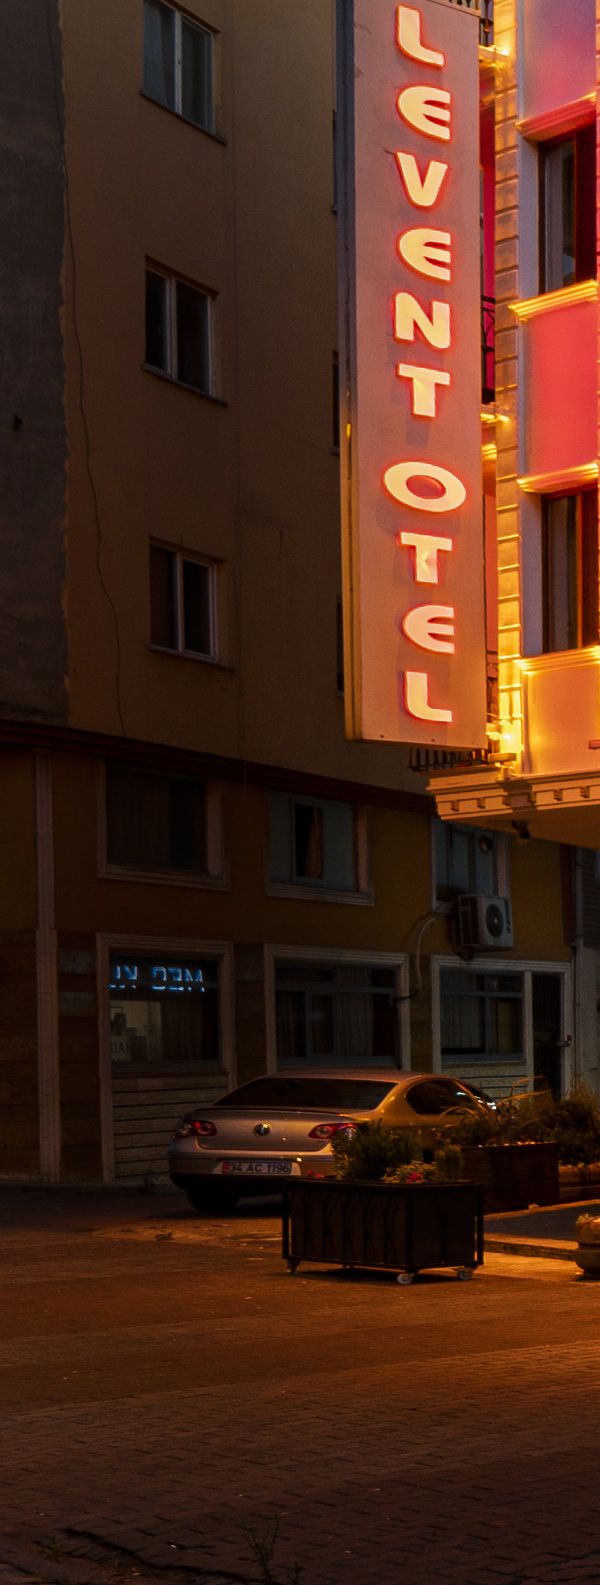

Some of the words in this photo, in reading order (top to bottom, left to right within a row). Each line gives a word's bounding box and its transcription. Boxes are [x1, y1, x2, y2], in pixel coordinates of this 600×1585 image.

[394, 4, 451, 418] LEVENT
[383, 460, 467, 723] OTEL
[230, 1163, 242, 1172] 34
[246, 1163, 262, 1173] AC
